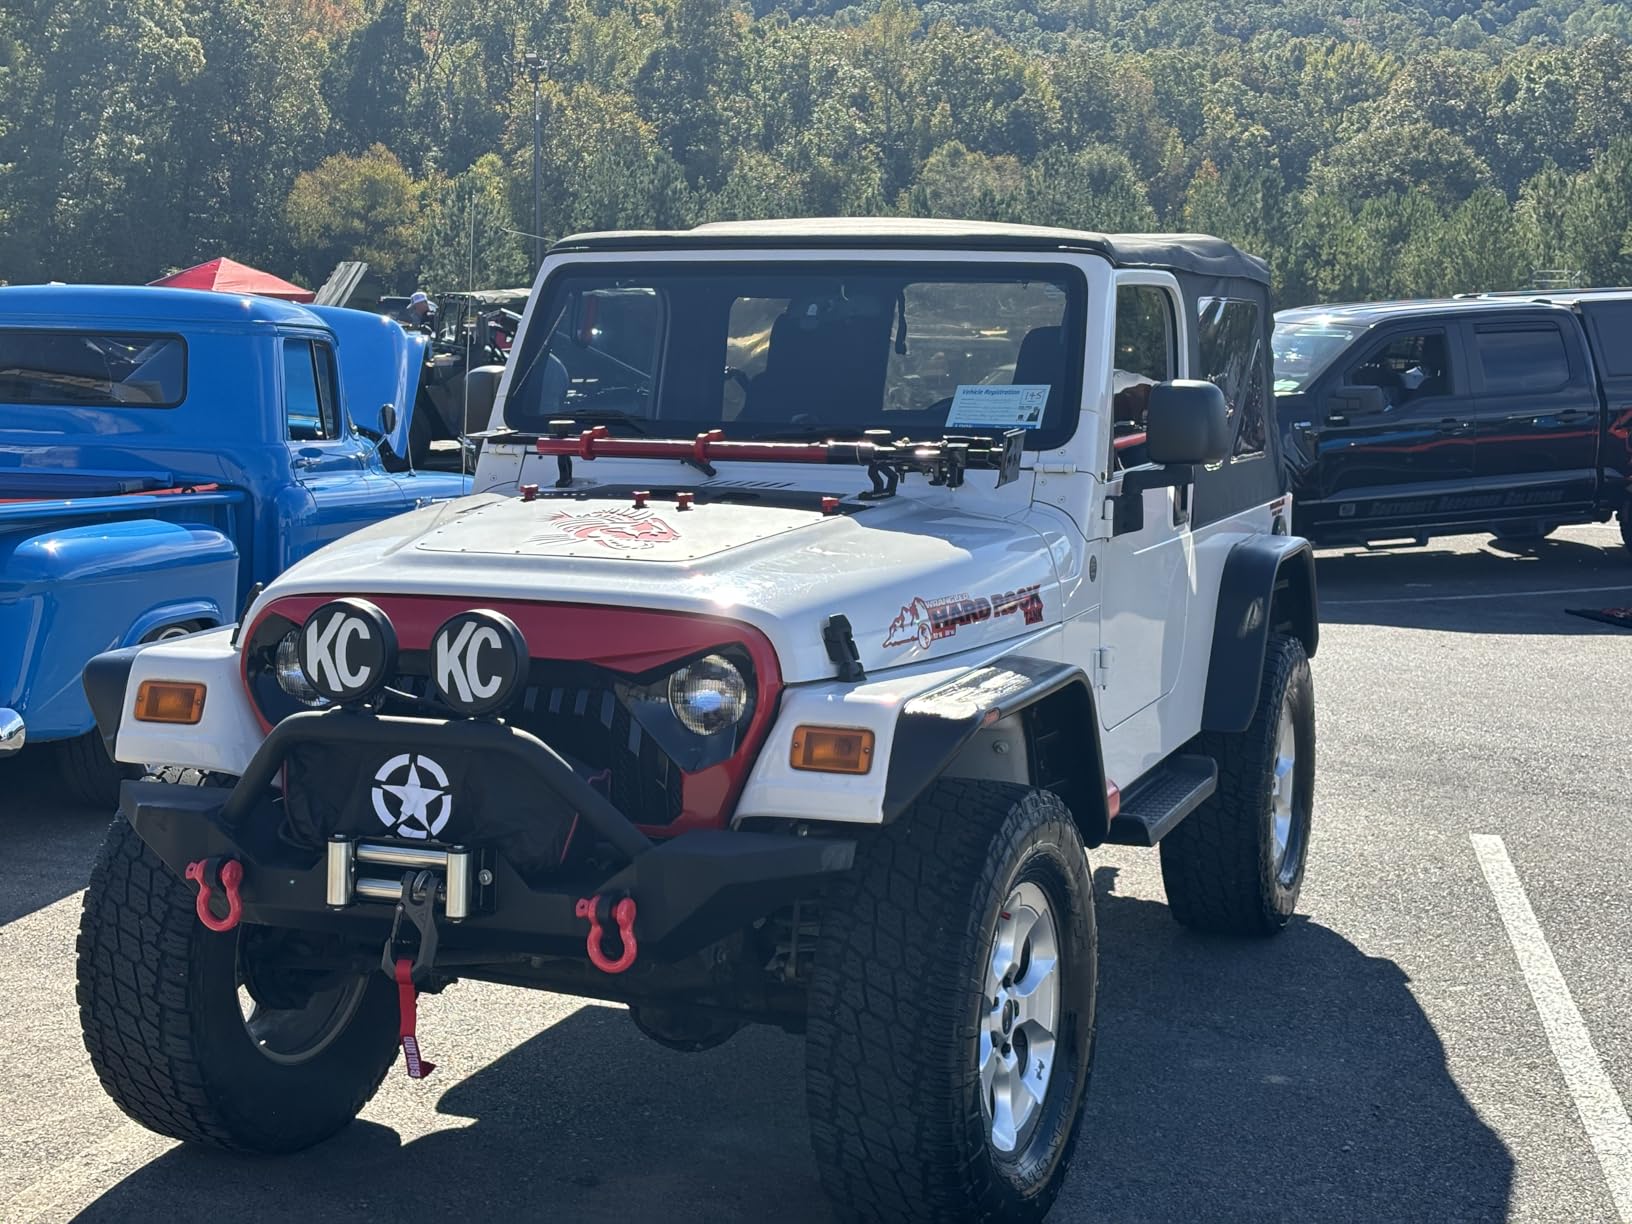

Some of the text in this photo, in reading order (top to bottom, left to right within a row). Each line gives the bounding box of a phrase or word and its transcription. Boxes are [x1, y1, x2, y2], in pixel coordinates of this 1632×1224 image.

[929, 597, 991, 629] HARD
[306, 612, 371, 692] KC
[437, 621, 503, 702] KC
[403, 1036, 421, 1078] BADLAND
